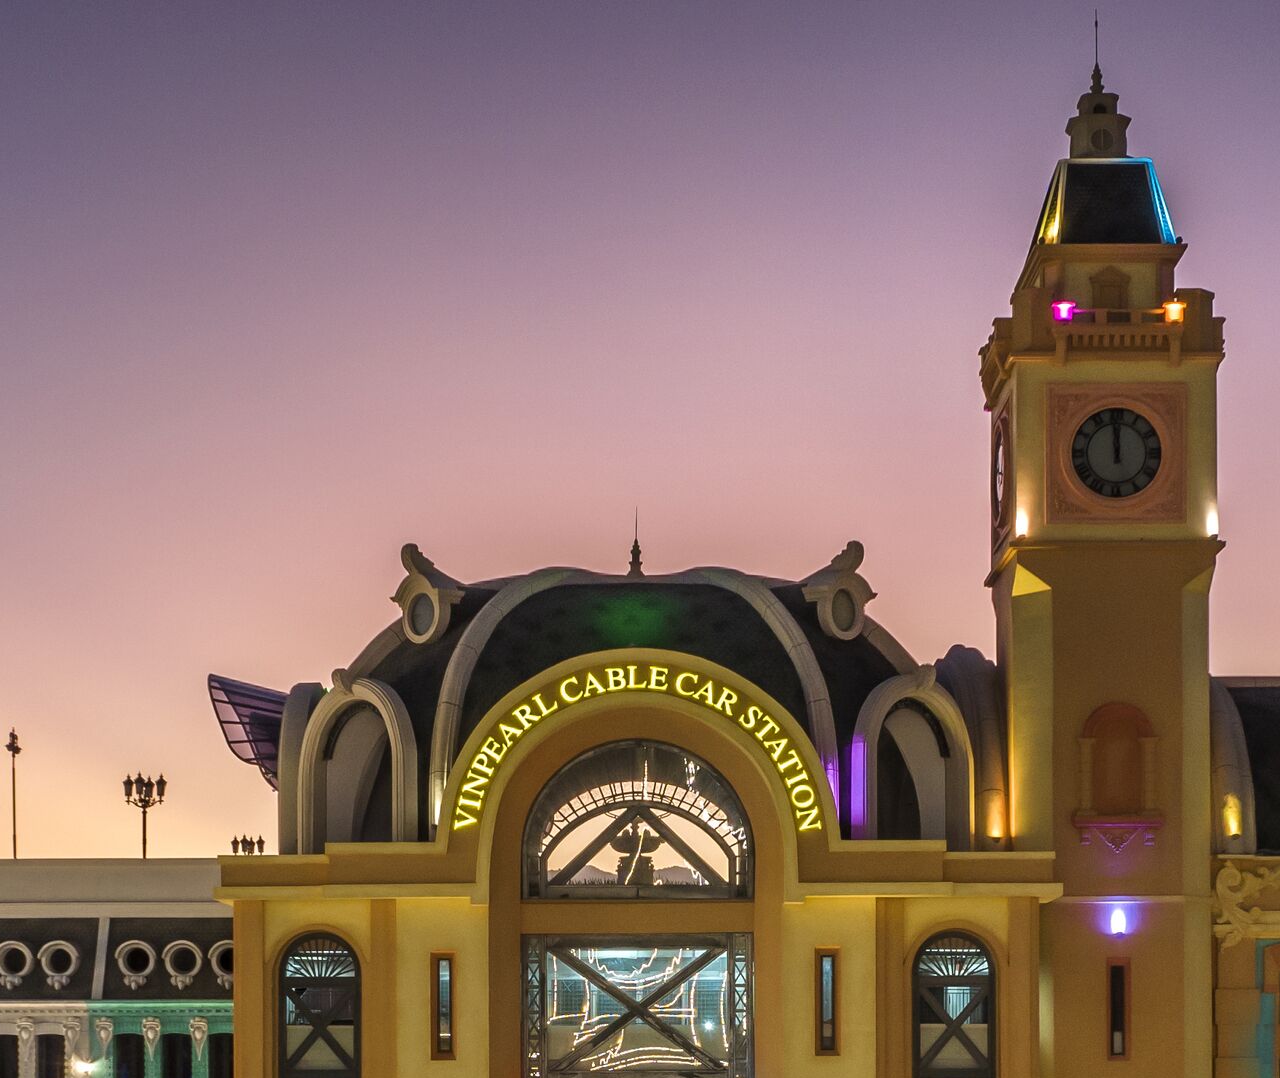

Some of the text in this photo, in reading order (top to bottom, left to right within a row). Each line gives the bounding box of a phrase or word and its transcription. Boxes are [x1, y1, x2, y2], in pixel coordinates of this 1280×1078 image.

[453, 665, 823, 833] VINPEARL CABLE CAR STATION
